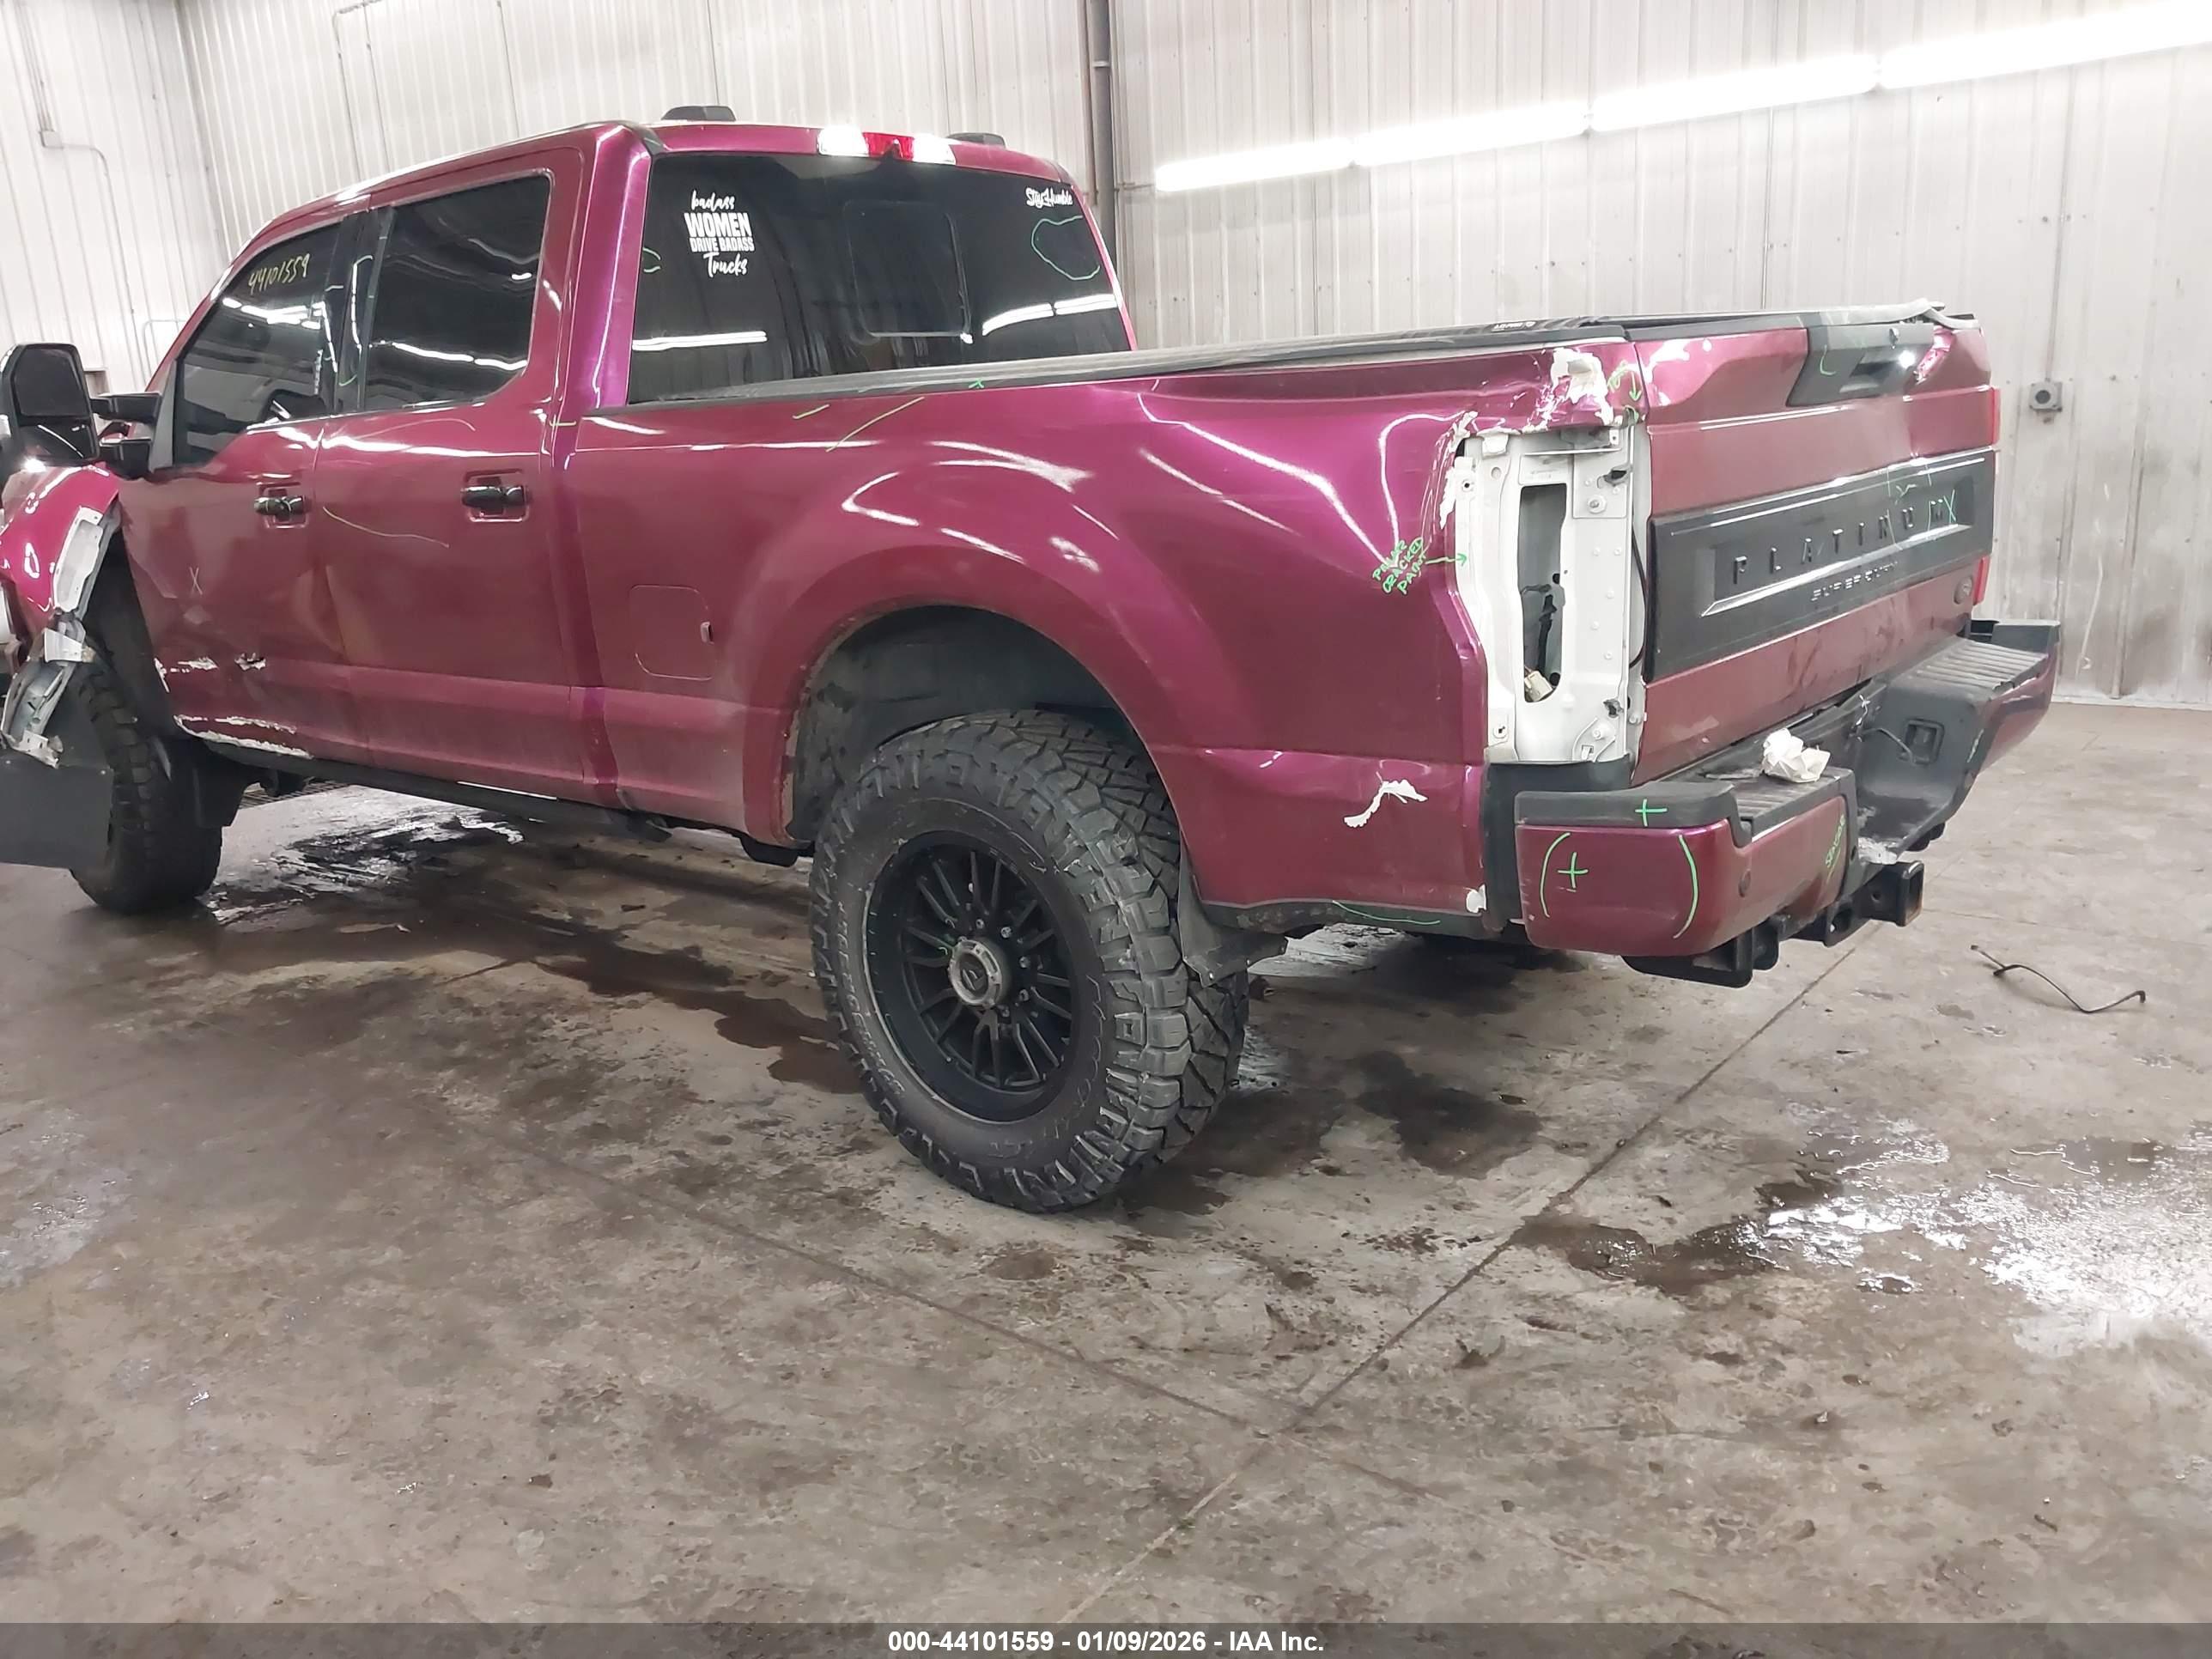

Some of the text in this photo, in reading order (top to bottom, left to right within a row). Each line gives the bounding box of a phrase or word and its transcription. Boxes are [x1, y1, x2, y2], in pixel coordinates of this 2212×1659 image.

[691, 189, 735, 212] badass
[684, 212, 752, 237] WOMEN
[689, 236, 756, 252] DRIVE BADASS
[248, 252, 310, 295] 44101559
[703, 252, 748, 277] Trucks
[1732, 498, 1946, 585] PLATINUM
